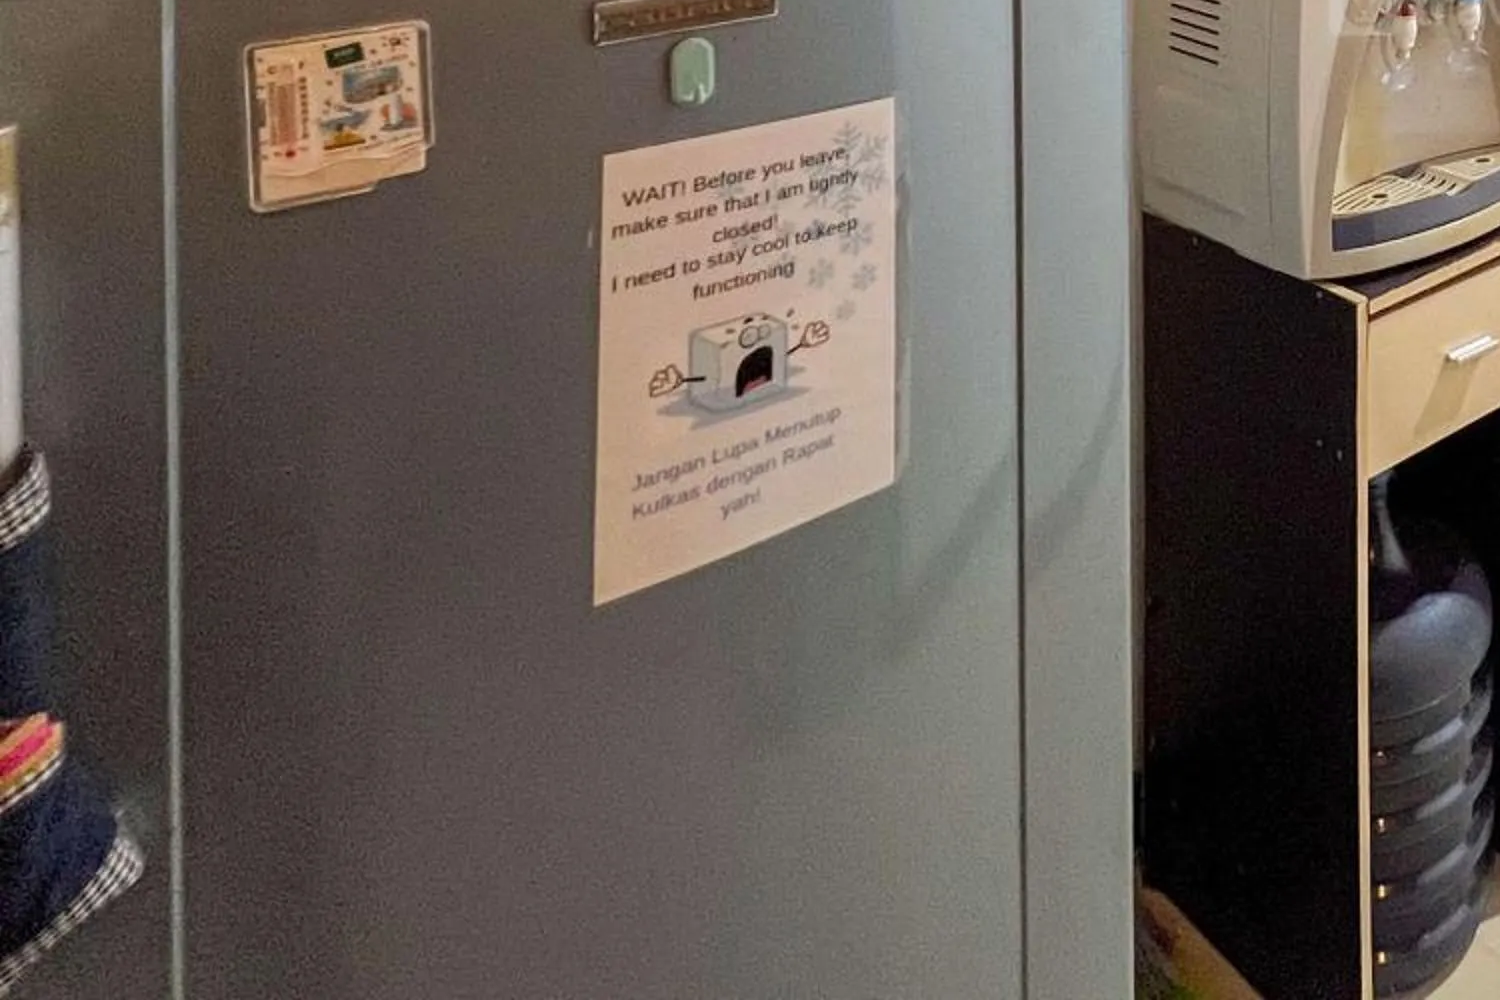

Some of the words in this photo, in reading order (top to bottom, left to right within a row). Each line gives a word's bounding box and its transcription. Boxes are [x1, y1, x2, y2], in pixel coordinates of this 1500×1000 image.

[622, 182, 686, 208] WAIT!
[693, 168, 756, 193] Before
[762, 158, 794, 181] you
[611, 214, 668, 239] make
[675, 203, 717, 224] sure
[724, 195, 759, 213] that
[765, 189, 770, 203] I
[777, 184, 802, 201] am
[611, 277, 617, 293] I
[625, 263, 675, 288] need
[682, 259, 700, 275] to
[707, 246, 746, 269] stay
[752, 235, 788, 257] cool
[795, 231, 809, 245] to
[816, 217, 857, 239] keep
[693, 261, 795, 300] functioning
[632, 486, 701, 519] Kulkas
[707, 457, 776, 490] dengan
[782, 435, 835, 465] Rapat
[633, 457, 704, 492] Jangan
[712, 438, 759, 464] Lupa
[764, 407, 841, 442] Menutup
[720, 489, 761, 520] yah!
